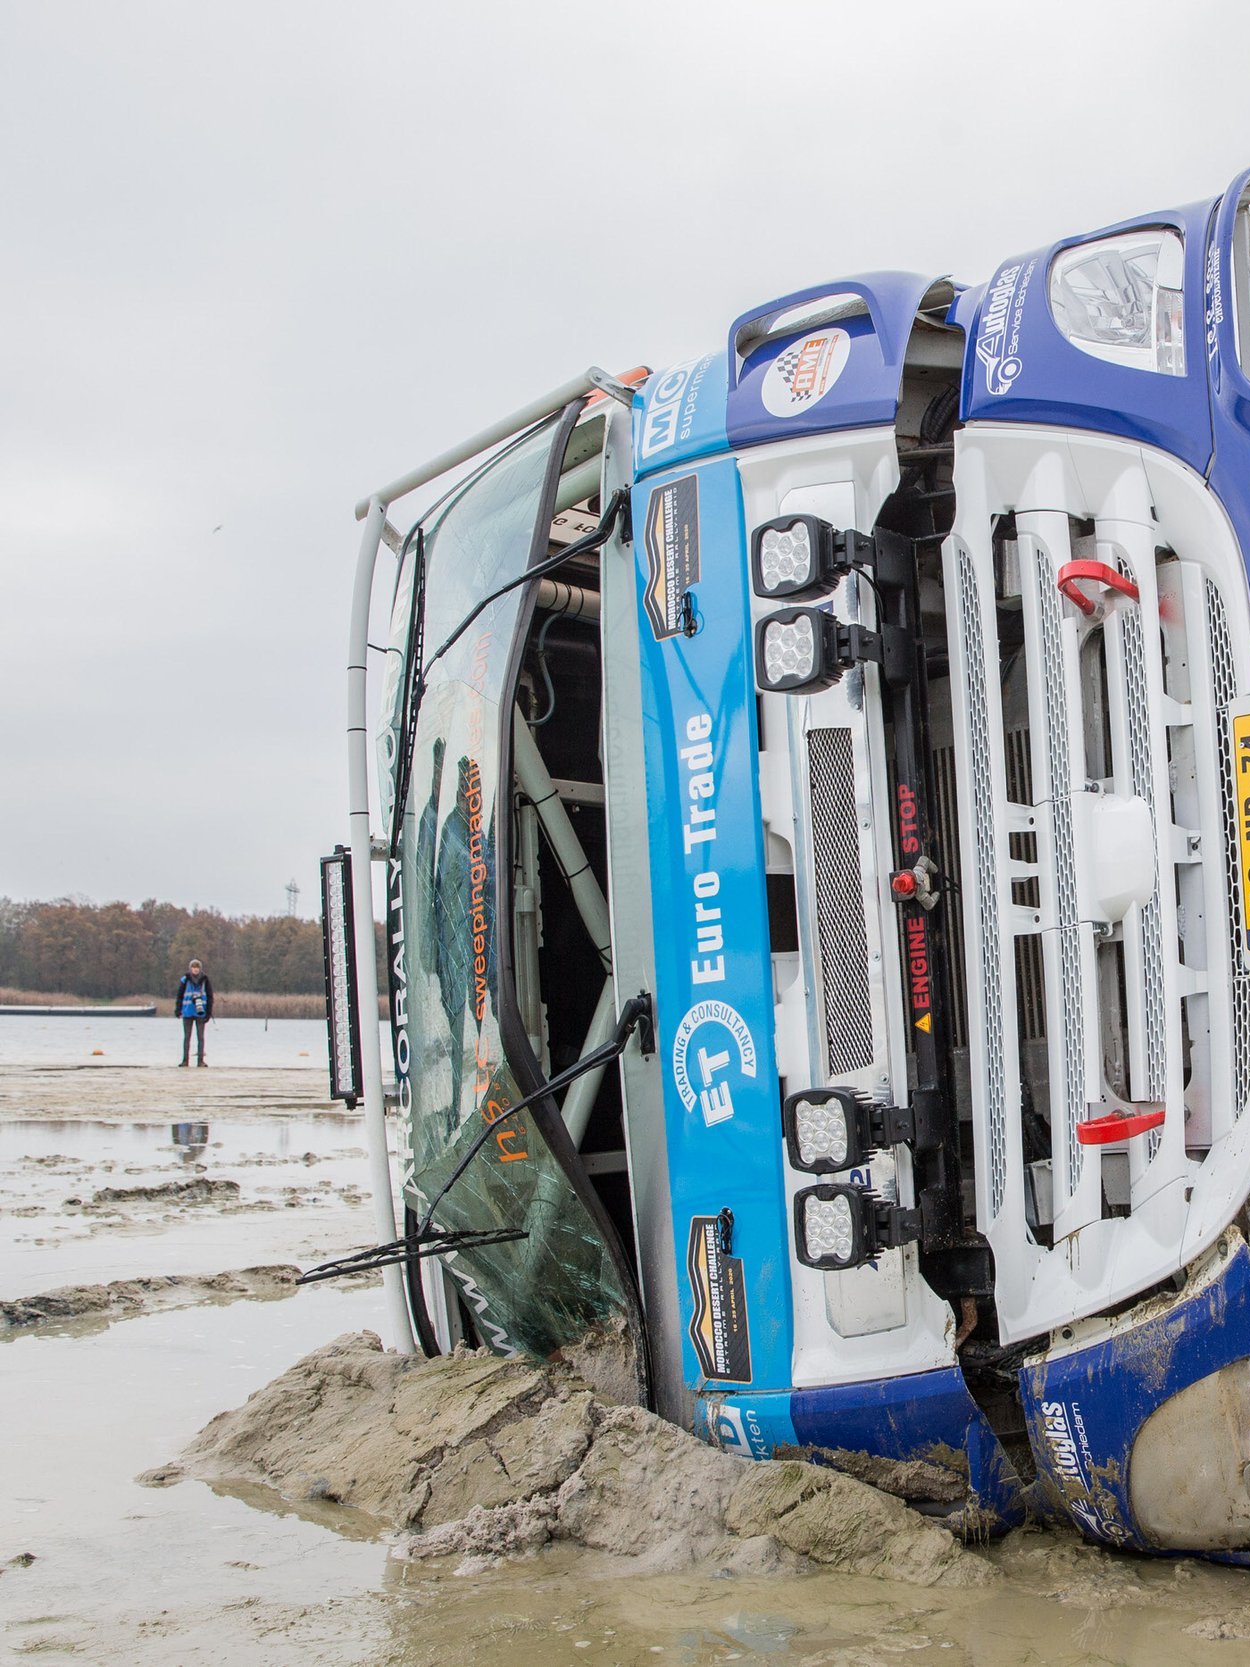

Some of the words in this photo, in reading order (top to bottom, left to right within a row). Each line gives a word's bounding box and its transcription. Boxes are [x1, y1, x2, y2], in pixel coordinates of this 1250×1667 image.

[976, 265, 1020, 357] Autoglas
[1015, 257, 1038, 308] Schiedam
[1008, 308, 1023, 355] Service
[796, 340, 824, 389] AME
[680, 353, 714, 440] supermar
[664, 489, 674, 543] CHALLENGE
[665, 544, 676, 582] DESERT
[666, 580, 677, 630] MOROCCO
[680, 713, 717, 854] Trade
[898, 783, 919, 854] STOP
[691, 871, 726, 984] Euro
[907, 916, 930, 1009] ENGINE
[683, 1022, 692, 1035] &
[691, 1003, 755, 1068] CONSULTANCY
[675, 1036, 694, 1108] TRADING
[698, 1047, 735, 1128] ET
[705, 1223, 718, 1280] CHALLENGE
[711, 1280, 720, 1318] DESERT
[713, 1320, 726, 1374] MOROCCO
[721, 1310, 731, 1375] EXTREME
[745, 1409, 771, 1461] kten
[1041, 1401, 1084, 1492] toglas
